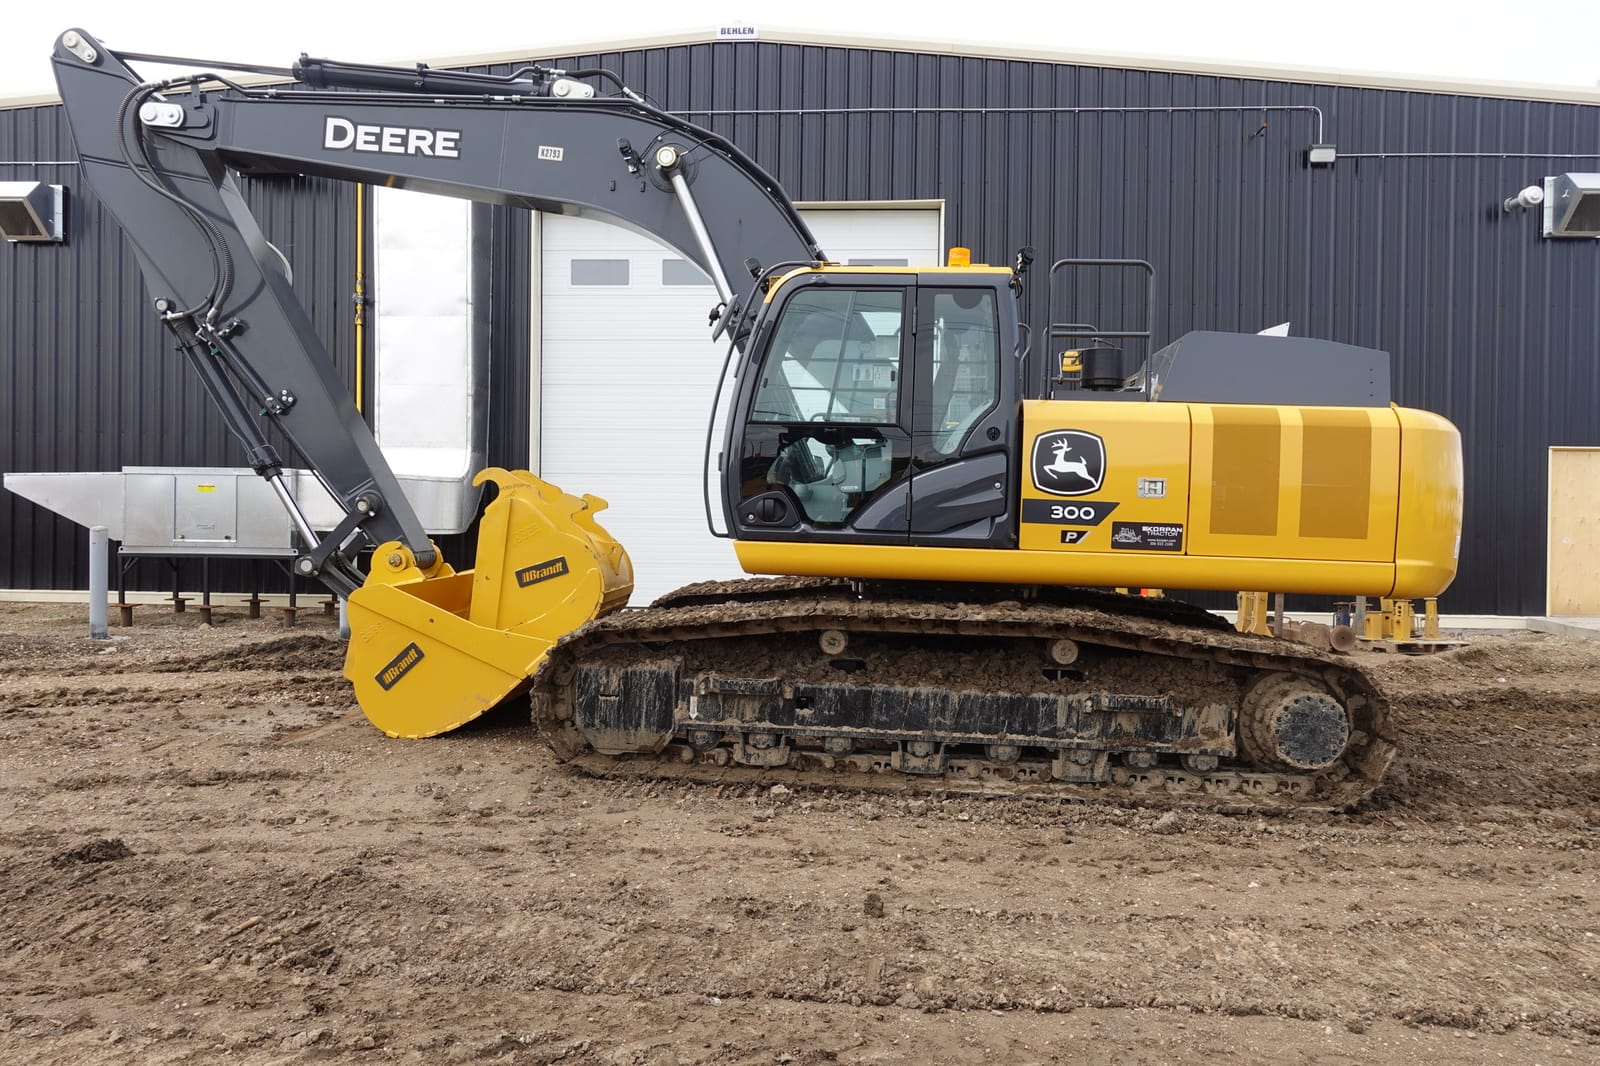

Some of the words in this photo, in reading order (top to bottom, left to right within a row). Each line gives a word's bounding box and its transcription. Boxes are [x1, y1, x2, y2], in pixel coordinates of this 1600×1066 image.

[720, 27, 754, 35] BEHLEN
[324, 117, 460, 157] DEERE
[1051, 505, 1095, 520] 300
[1065, 531, 1078, 542] P
